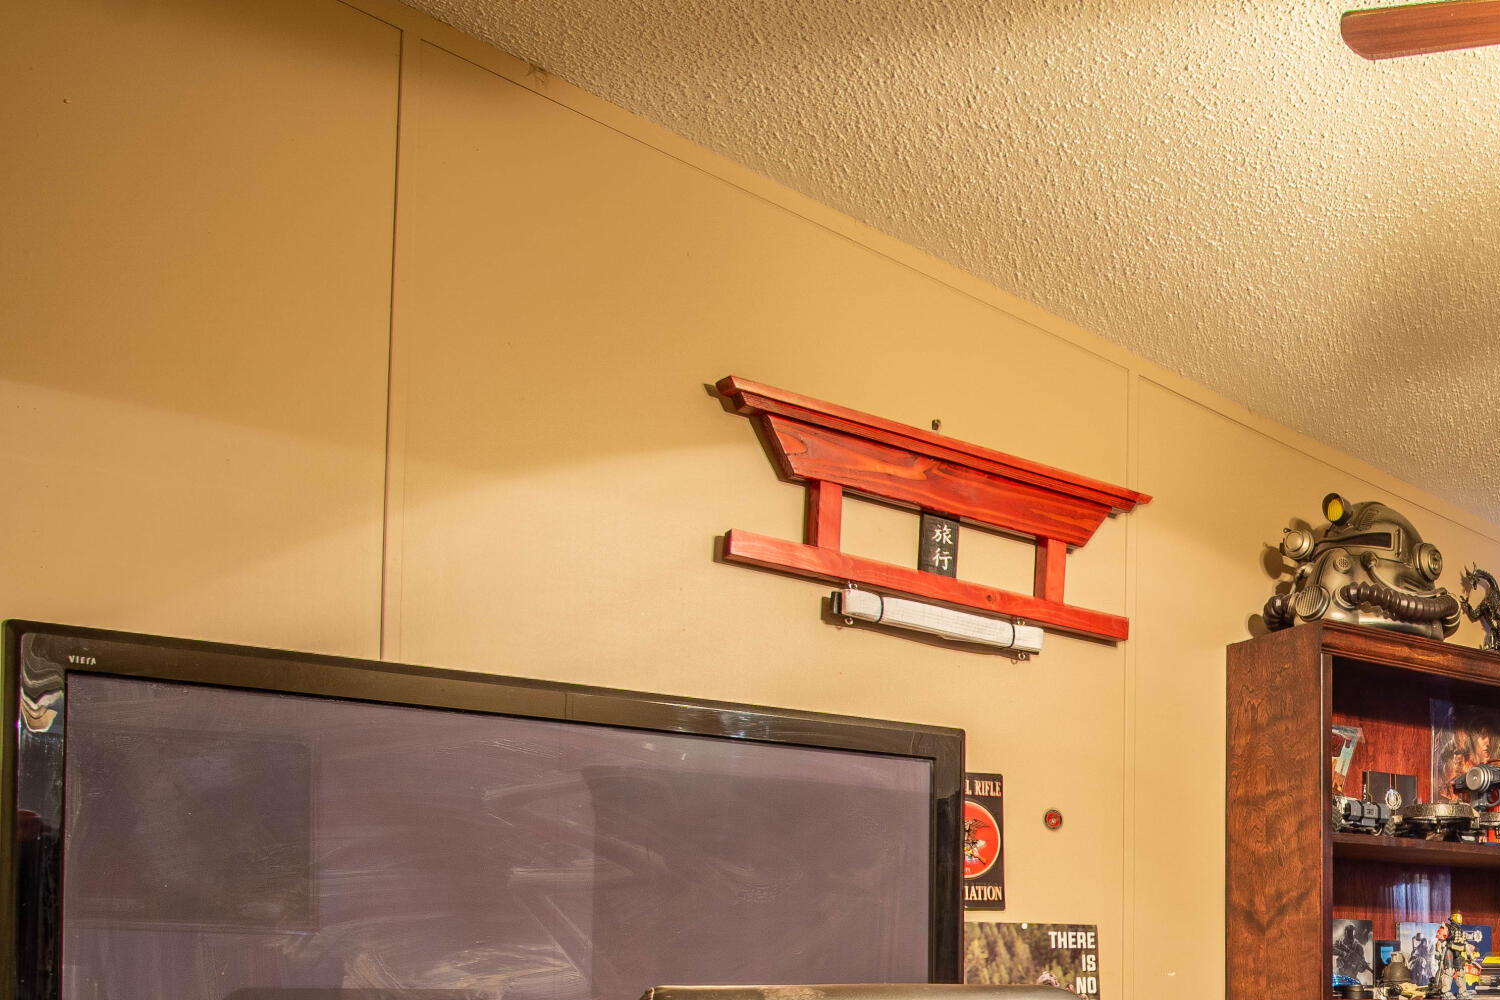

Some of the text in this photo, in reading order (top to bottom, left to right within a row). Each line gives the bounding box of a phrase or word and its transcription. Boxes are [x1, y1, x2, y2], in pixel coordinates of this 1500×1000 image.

[931, 523, 954, 571] 旅行
[974, 780, 1002, 797] RIFLE
[1048, 931, 1096, 949] THERE
[1082, 954, 1097, 972] IS
[1076, 976, 1097, 994] NO
